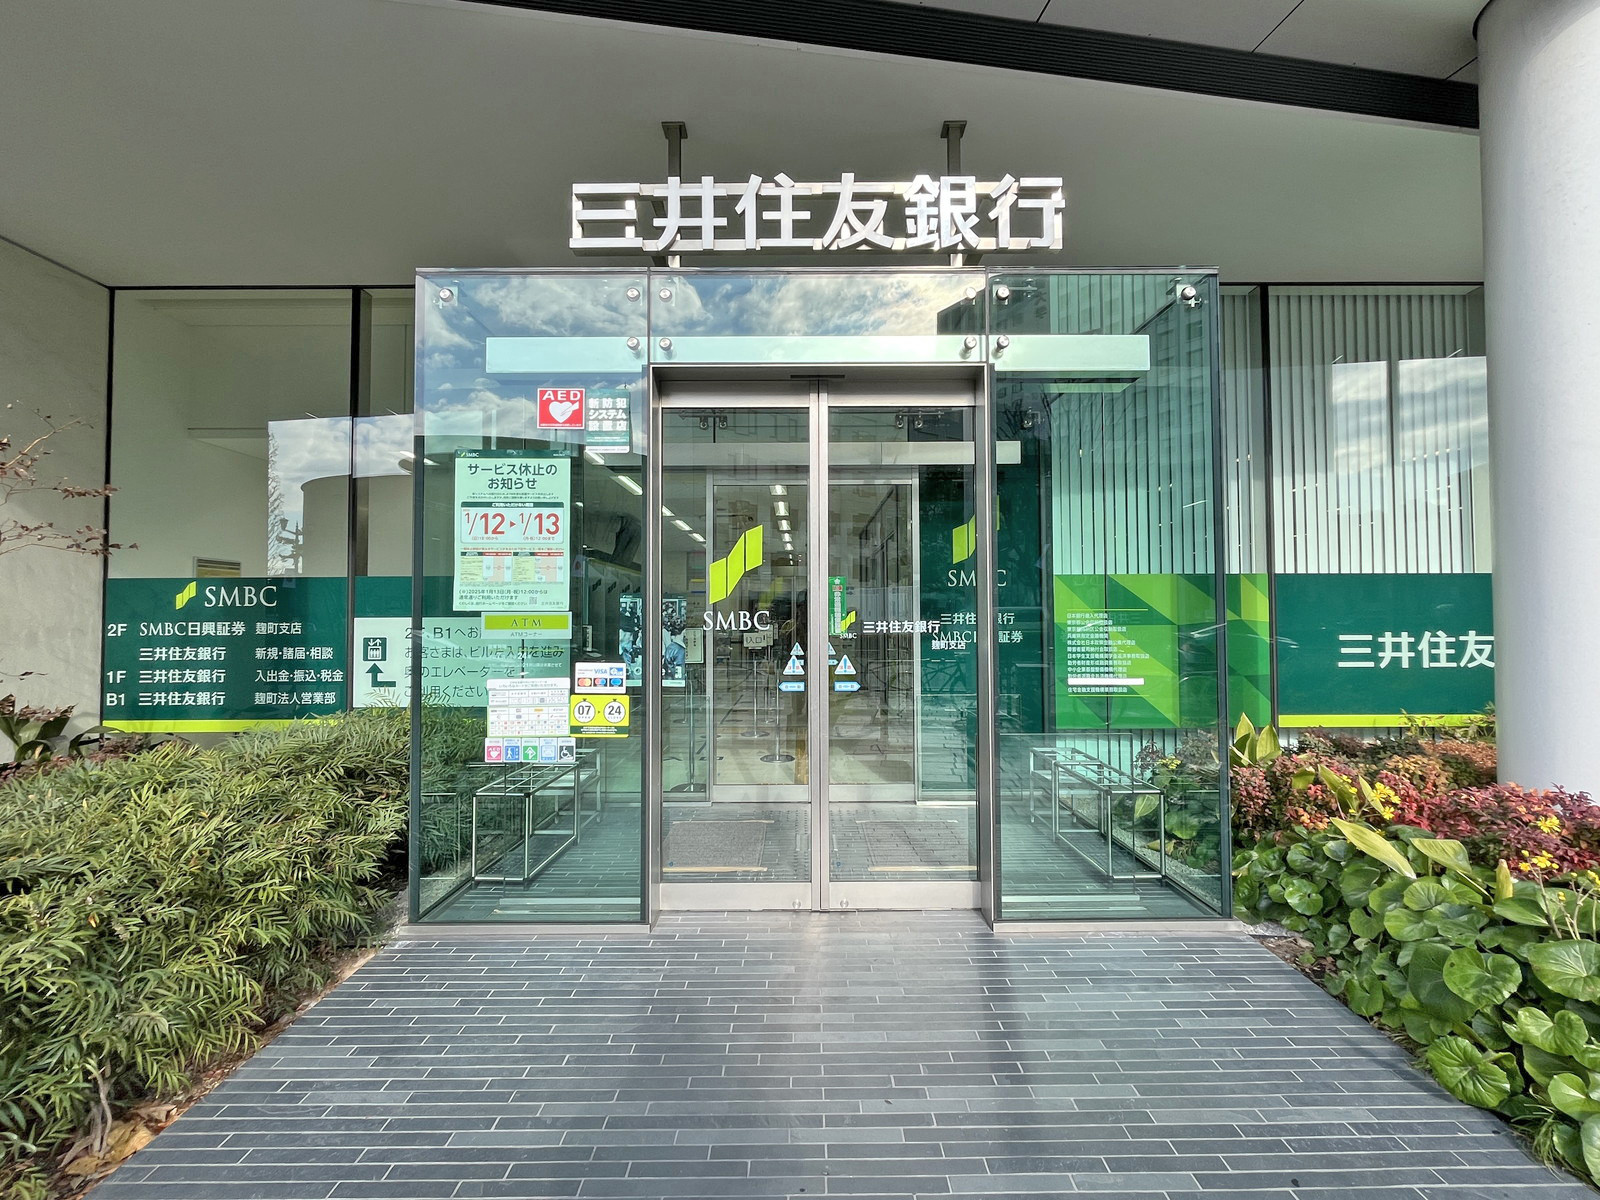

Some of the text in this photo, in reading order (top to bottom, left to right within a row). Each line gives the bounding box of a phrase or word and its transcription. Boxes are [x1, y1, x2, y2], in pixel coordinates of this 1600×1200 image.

[569, 173, 1065, 251] 三井住友銀行
[542, 390, 581, 401] AED
[588, 397, 627, 409] 新防犯
[588, 409, 627, 420] システム
[467, 463, 558, 477] サービス休止の
[487, 477, 538, 490] お知らせ
[464, 512, 560, 536] 1/12 1/13
[204, 585, 278, 607] SMBC
[511, 618, 542, 628] ATM
[702, 610, 771, 631] SMBC
[863, 619, 940, 634] 三井住友銀行
[107, 623, 128, 637] 2F
[139, 622, 246, 637] SMBC日興証券
[138, 647, 226, 662] 三井住友銀行
[106, 670, 127, 684] 1F
[138, 669, 226, 684] 三井住友銀行
[106, 692, 126, 706] B1
[138, 691, 226, 706] 三井住友銀行
[577, 705, 622, 716] 07 24
